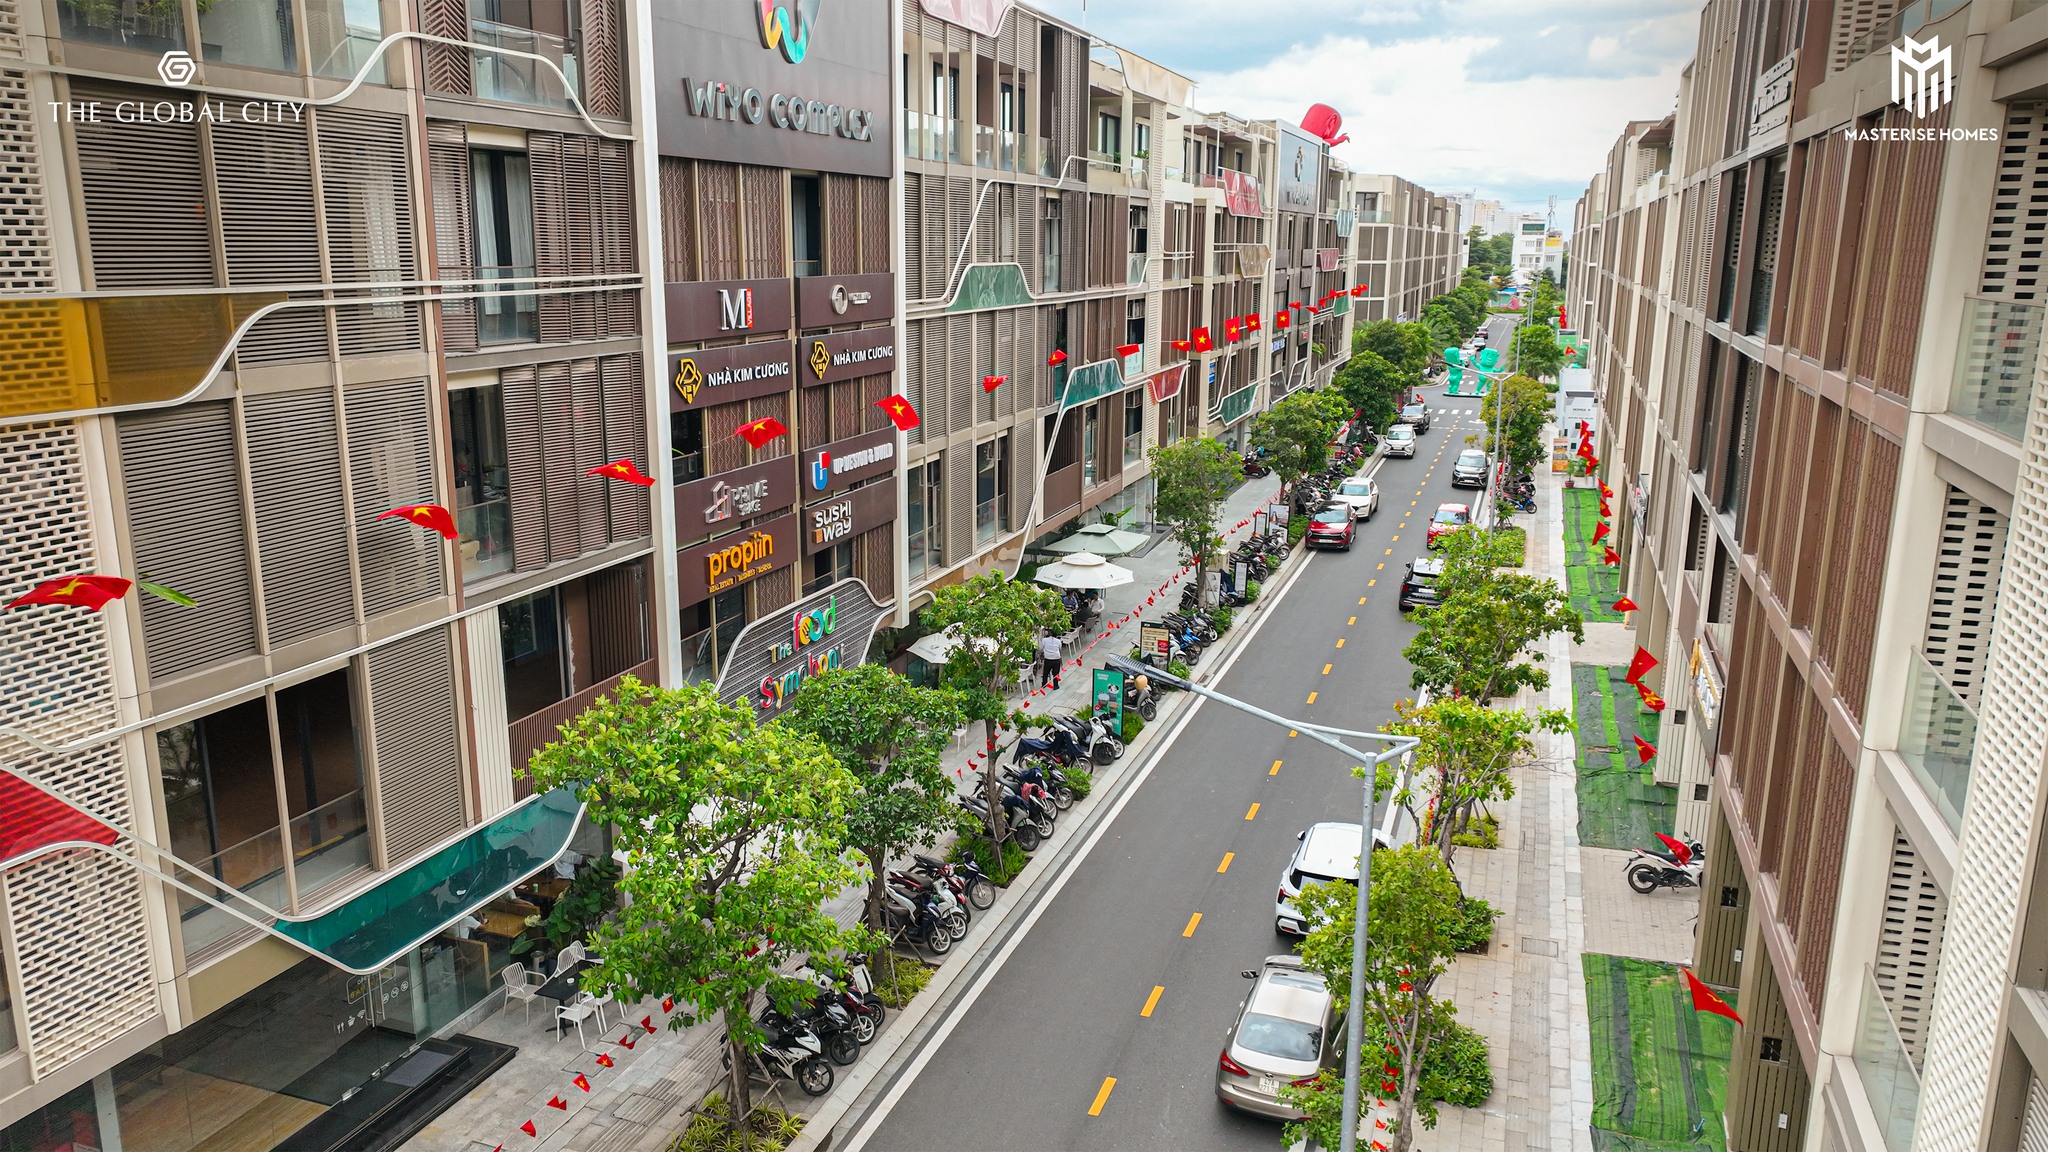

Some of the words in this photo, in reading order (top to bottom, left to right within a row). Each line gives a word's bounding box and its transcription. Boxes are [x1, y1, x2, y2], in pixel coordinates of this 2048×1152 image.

[718, 288, 748, 331] M
[833, 350, 851, 366] NHÀ
[852, 350, 867, 363] KIM
[867, 345, 893, 360] CƯƠNG
[708, 367, 732, 387] NHÀ
[733, 368, 753, 381] KIM
[755, 362, 789, 379] CƯƠNG
[769, 642, 792, 663] The
[792, 595, 836, 651] food
